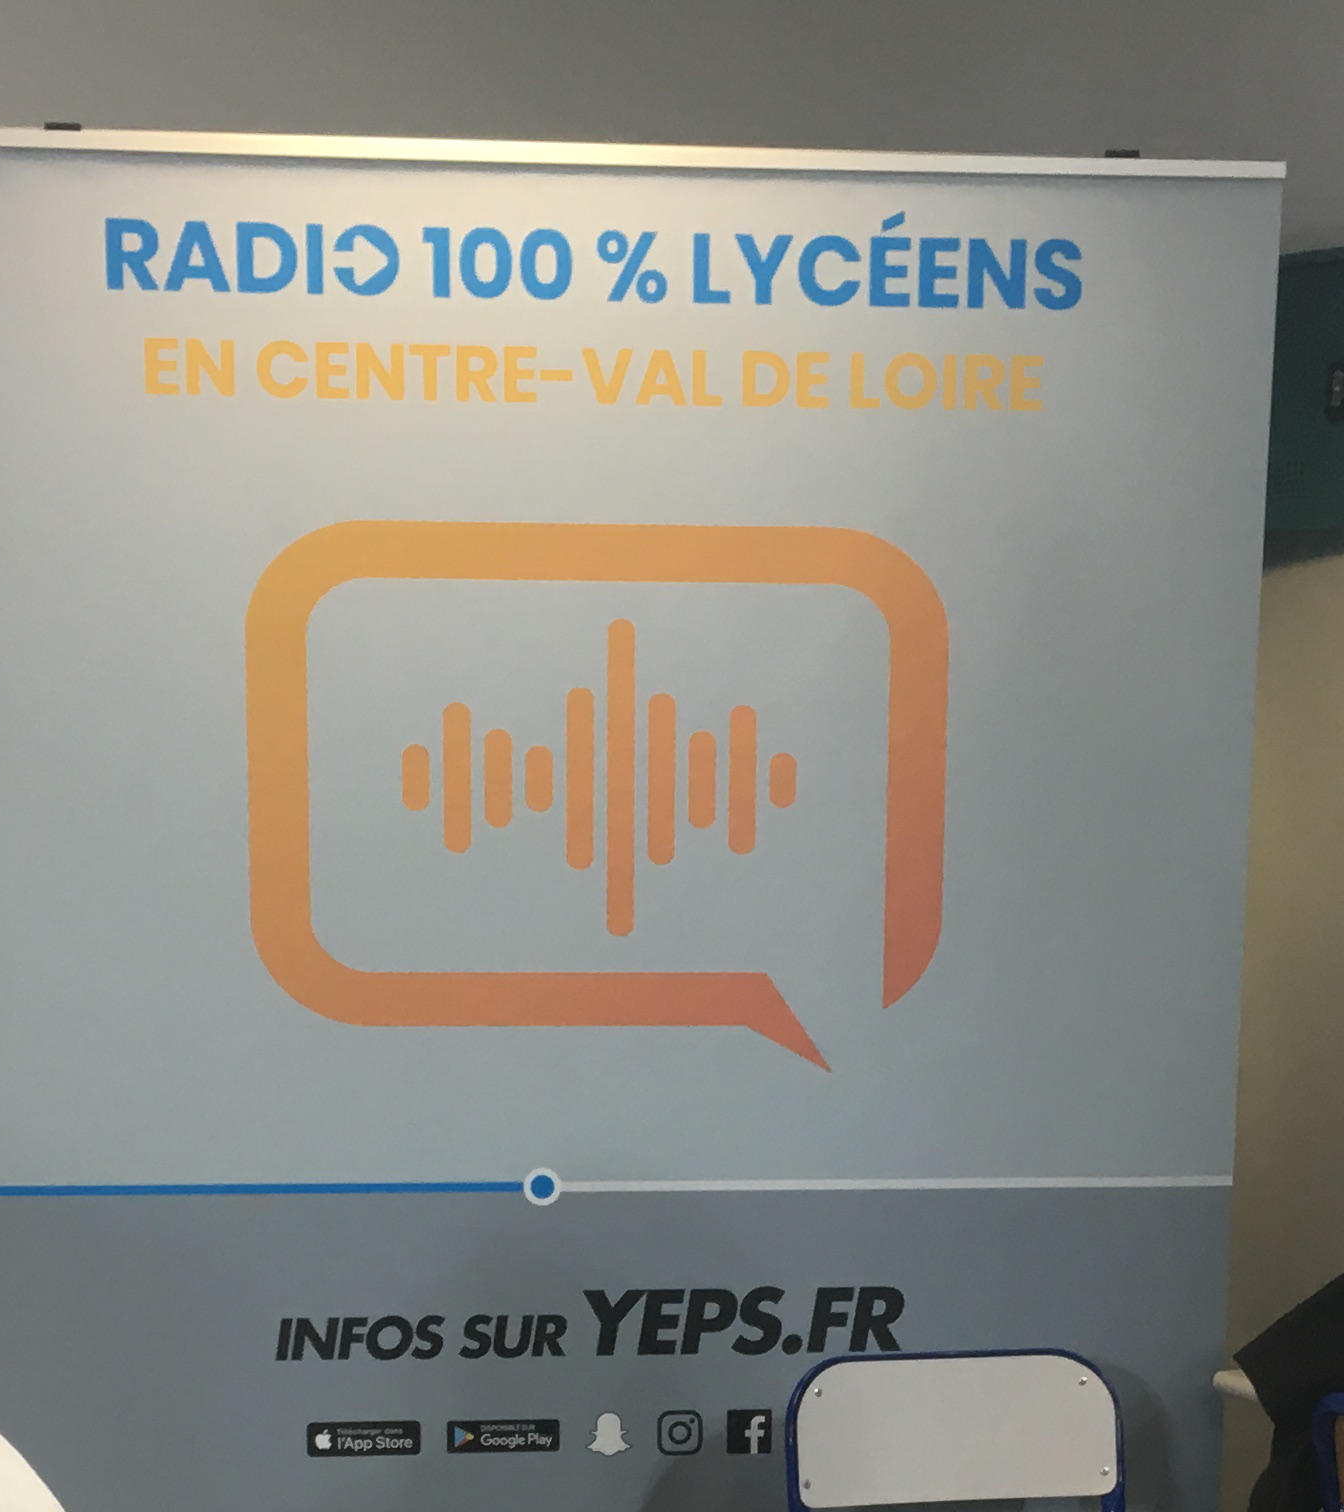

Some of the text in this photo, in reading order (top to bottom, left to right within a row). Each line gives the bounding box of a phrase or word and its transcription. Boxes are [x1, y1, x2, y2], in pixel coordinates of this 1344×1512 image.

[104, 210, 1084, 312] RADIO 100 % LYCÉENS
[144, 336, 1045, 412] EN CENTRE-VAL DE LOIRE
[275, 1285, 906, 1362] INFOS SUR YEPS.FR
[375, 1435, 413, 1450] Store
[480, 1432, 553, 1448] Google Play
